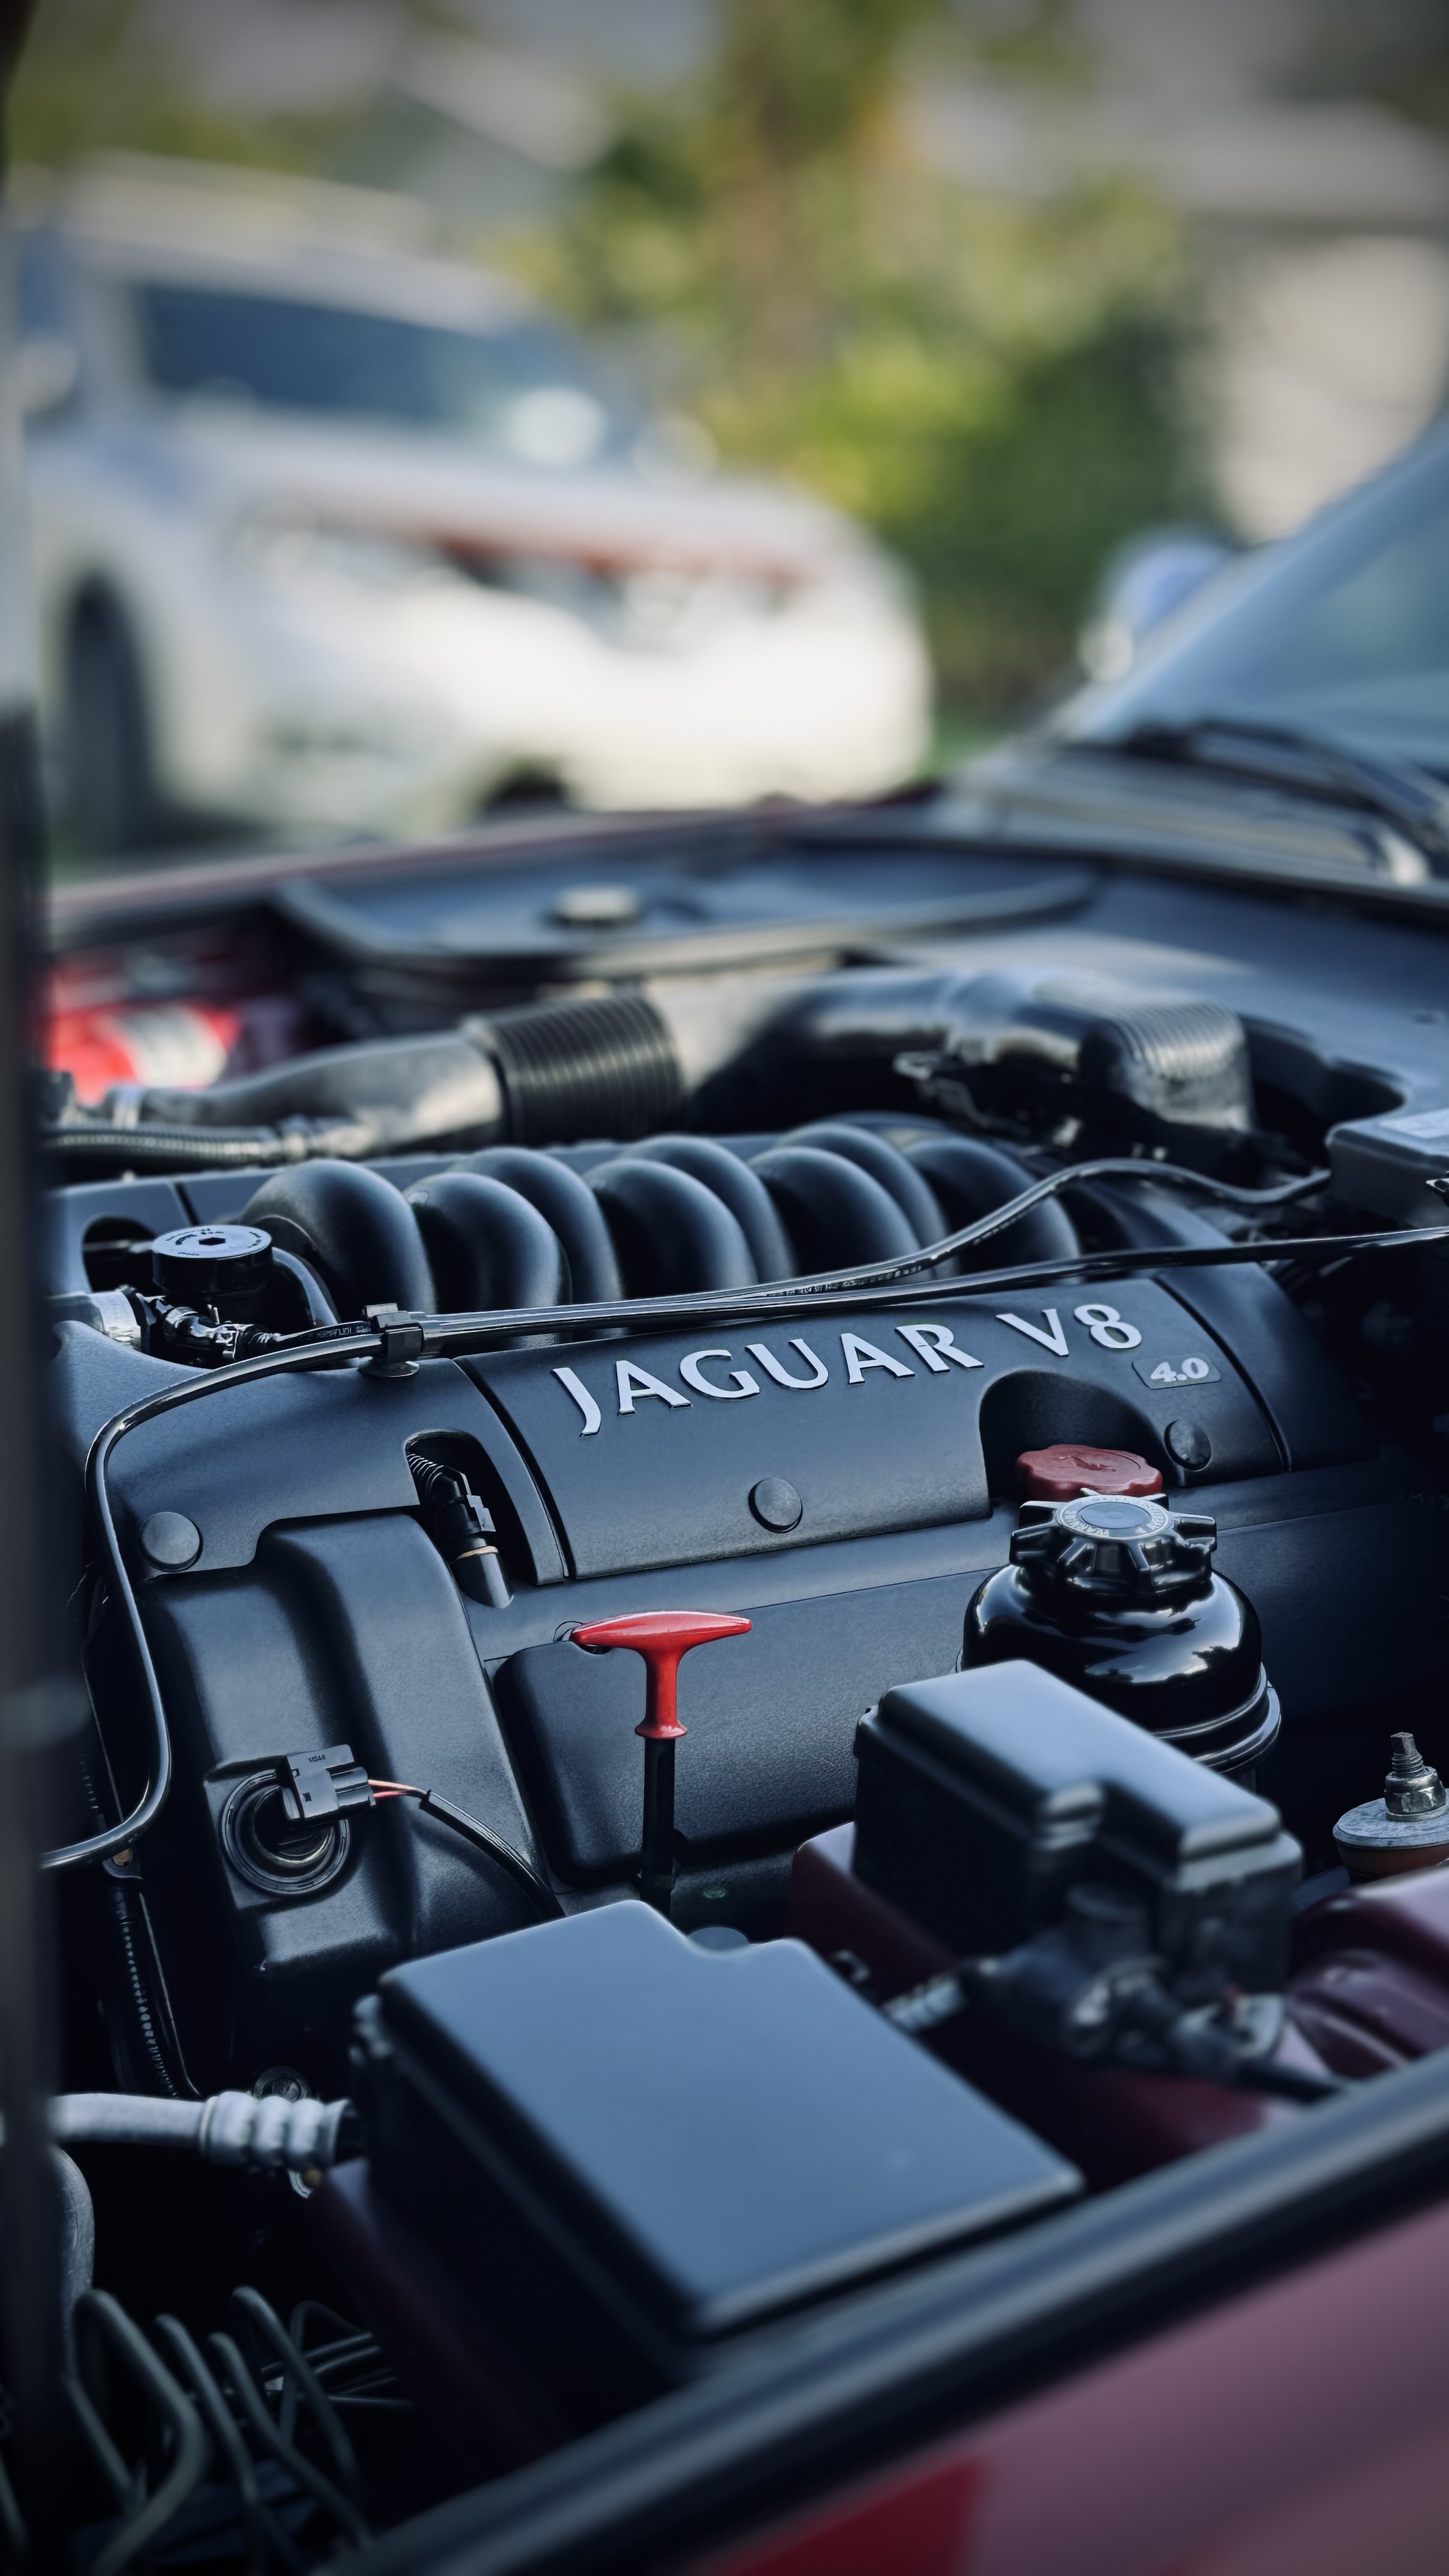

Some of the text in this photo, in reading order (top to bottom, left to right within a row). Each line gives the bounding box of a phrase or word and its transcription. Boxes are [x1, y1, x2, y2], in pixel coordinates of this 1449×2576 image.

[551, 1303, 1142, 1437] JAGUAR V8
[1150, 1357, 1209, 1383] 4.0
